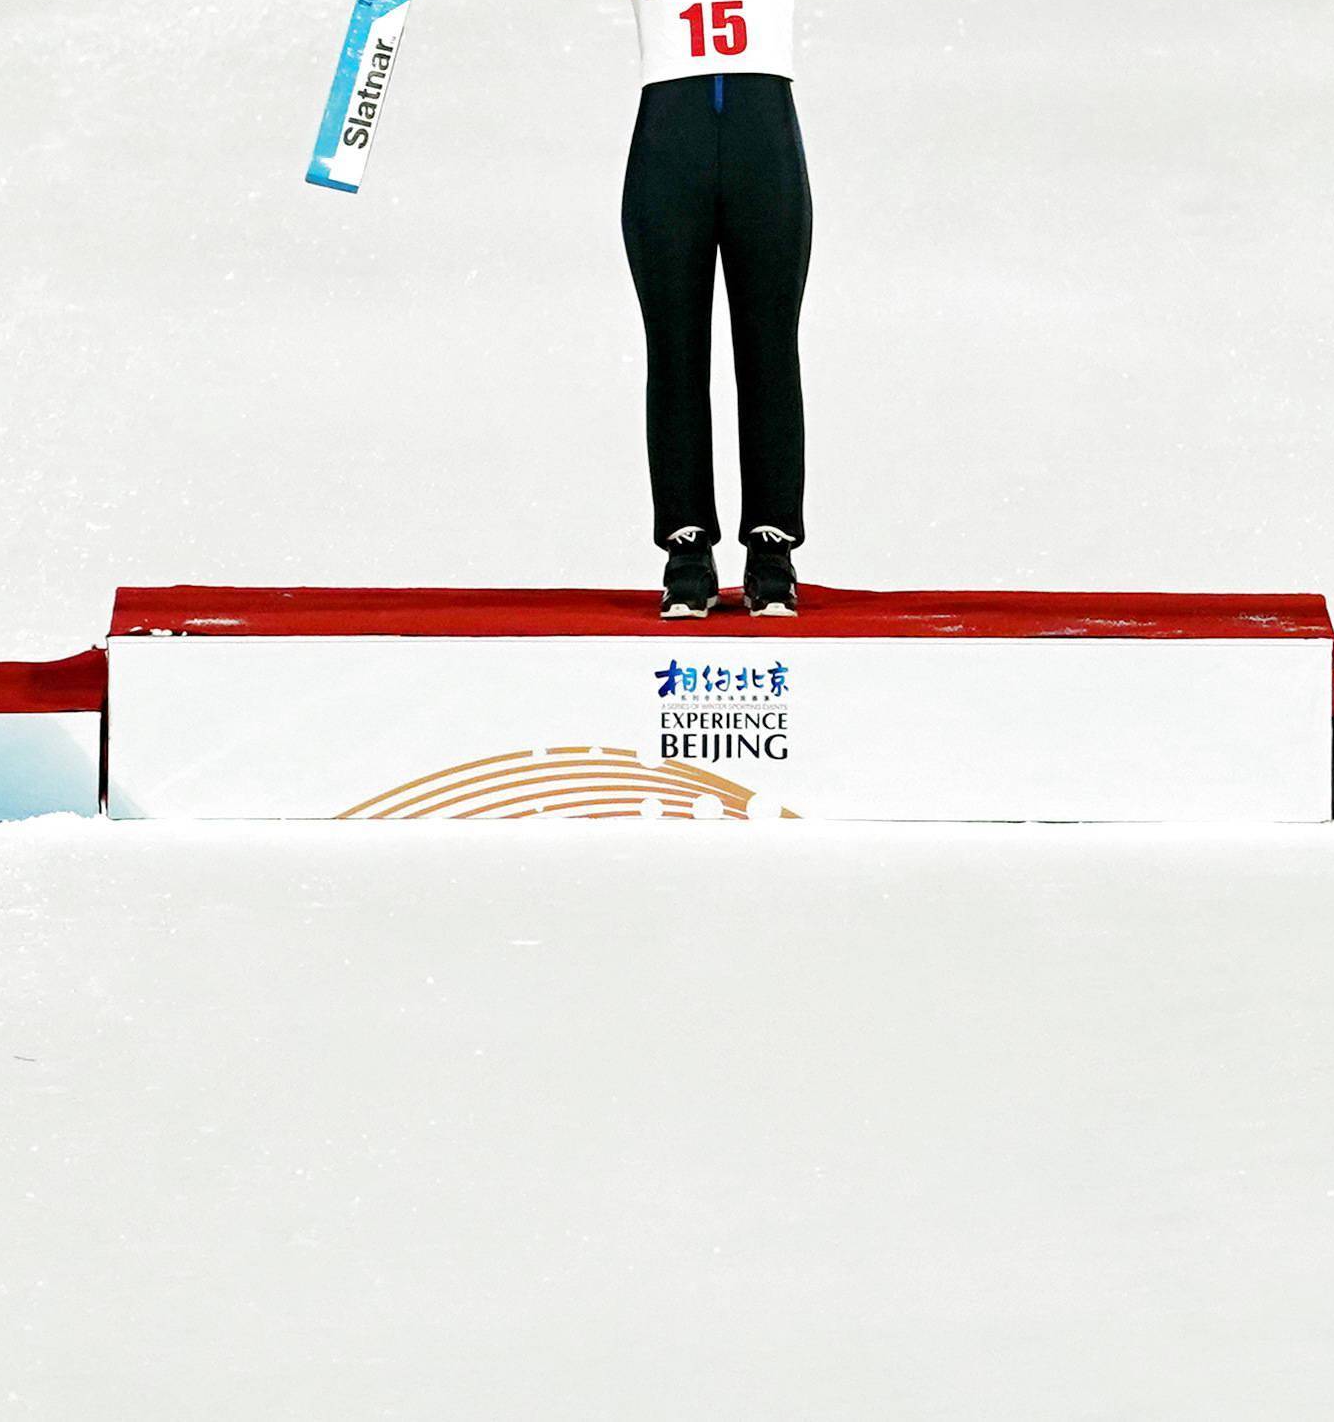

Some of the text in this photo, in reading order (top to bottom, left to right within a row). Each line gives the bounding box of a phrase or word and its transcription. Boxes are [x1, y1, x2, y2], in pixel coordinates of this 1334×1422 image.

[679, 0, 748, 58] 15
[343, 38, 395, 149] Slatnar
[654, 659, 789, 698] 相约北京
[661, 712, 788, 730] EXPERIENCE
[661, 733, 788, 763] BEIJING
